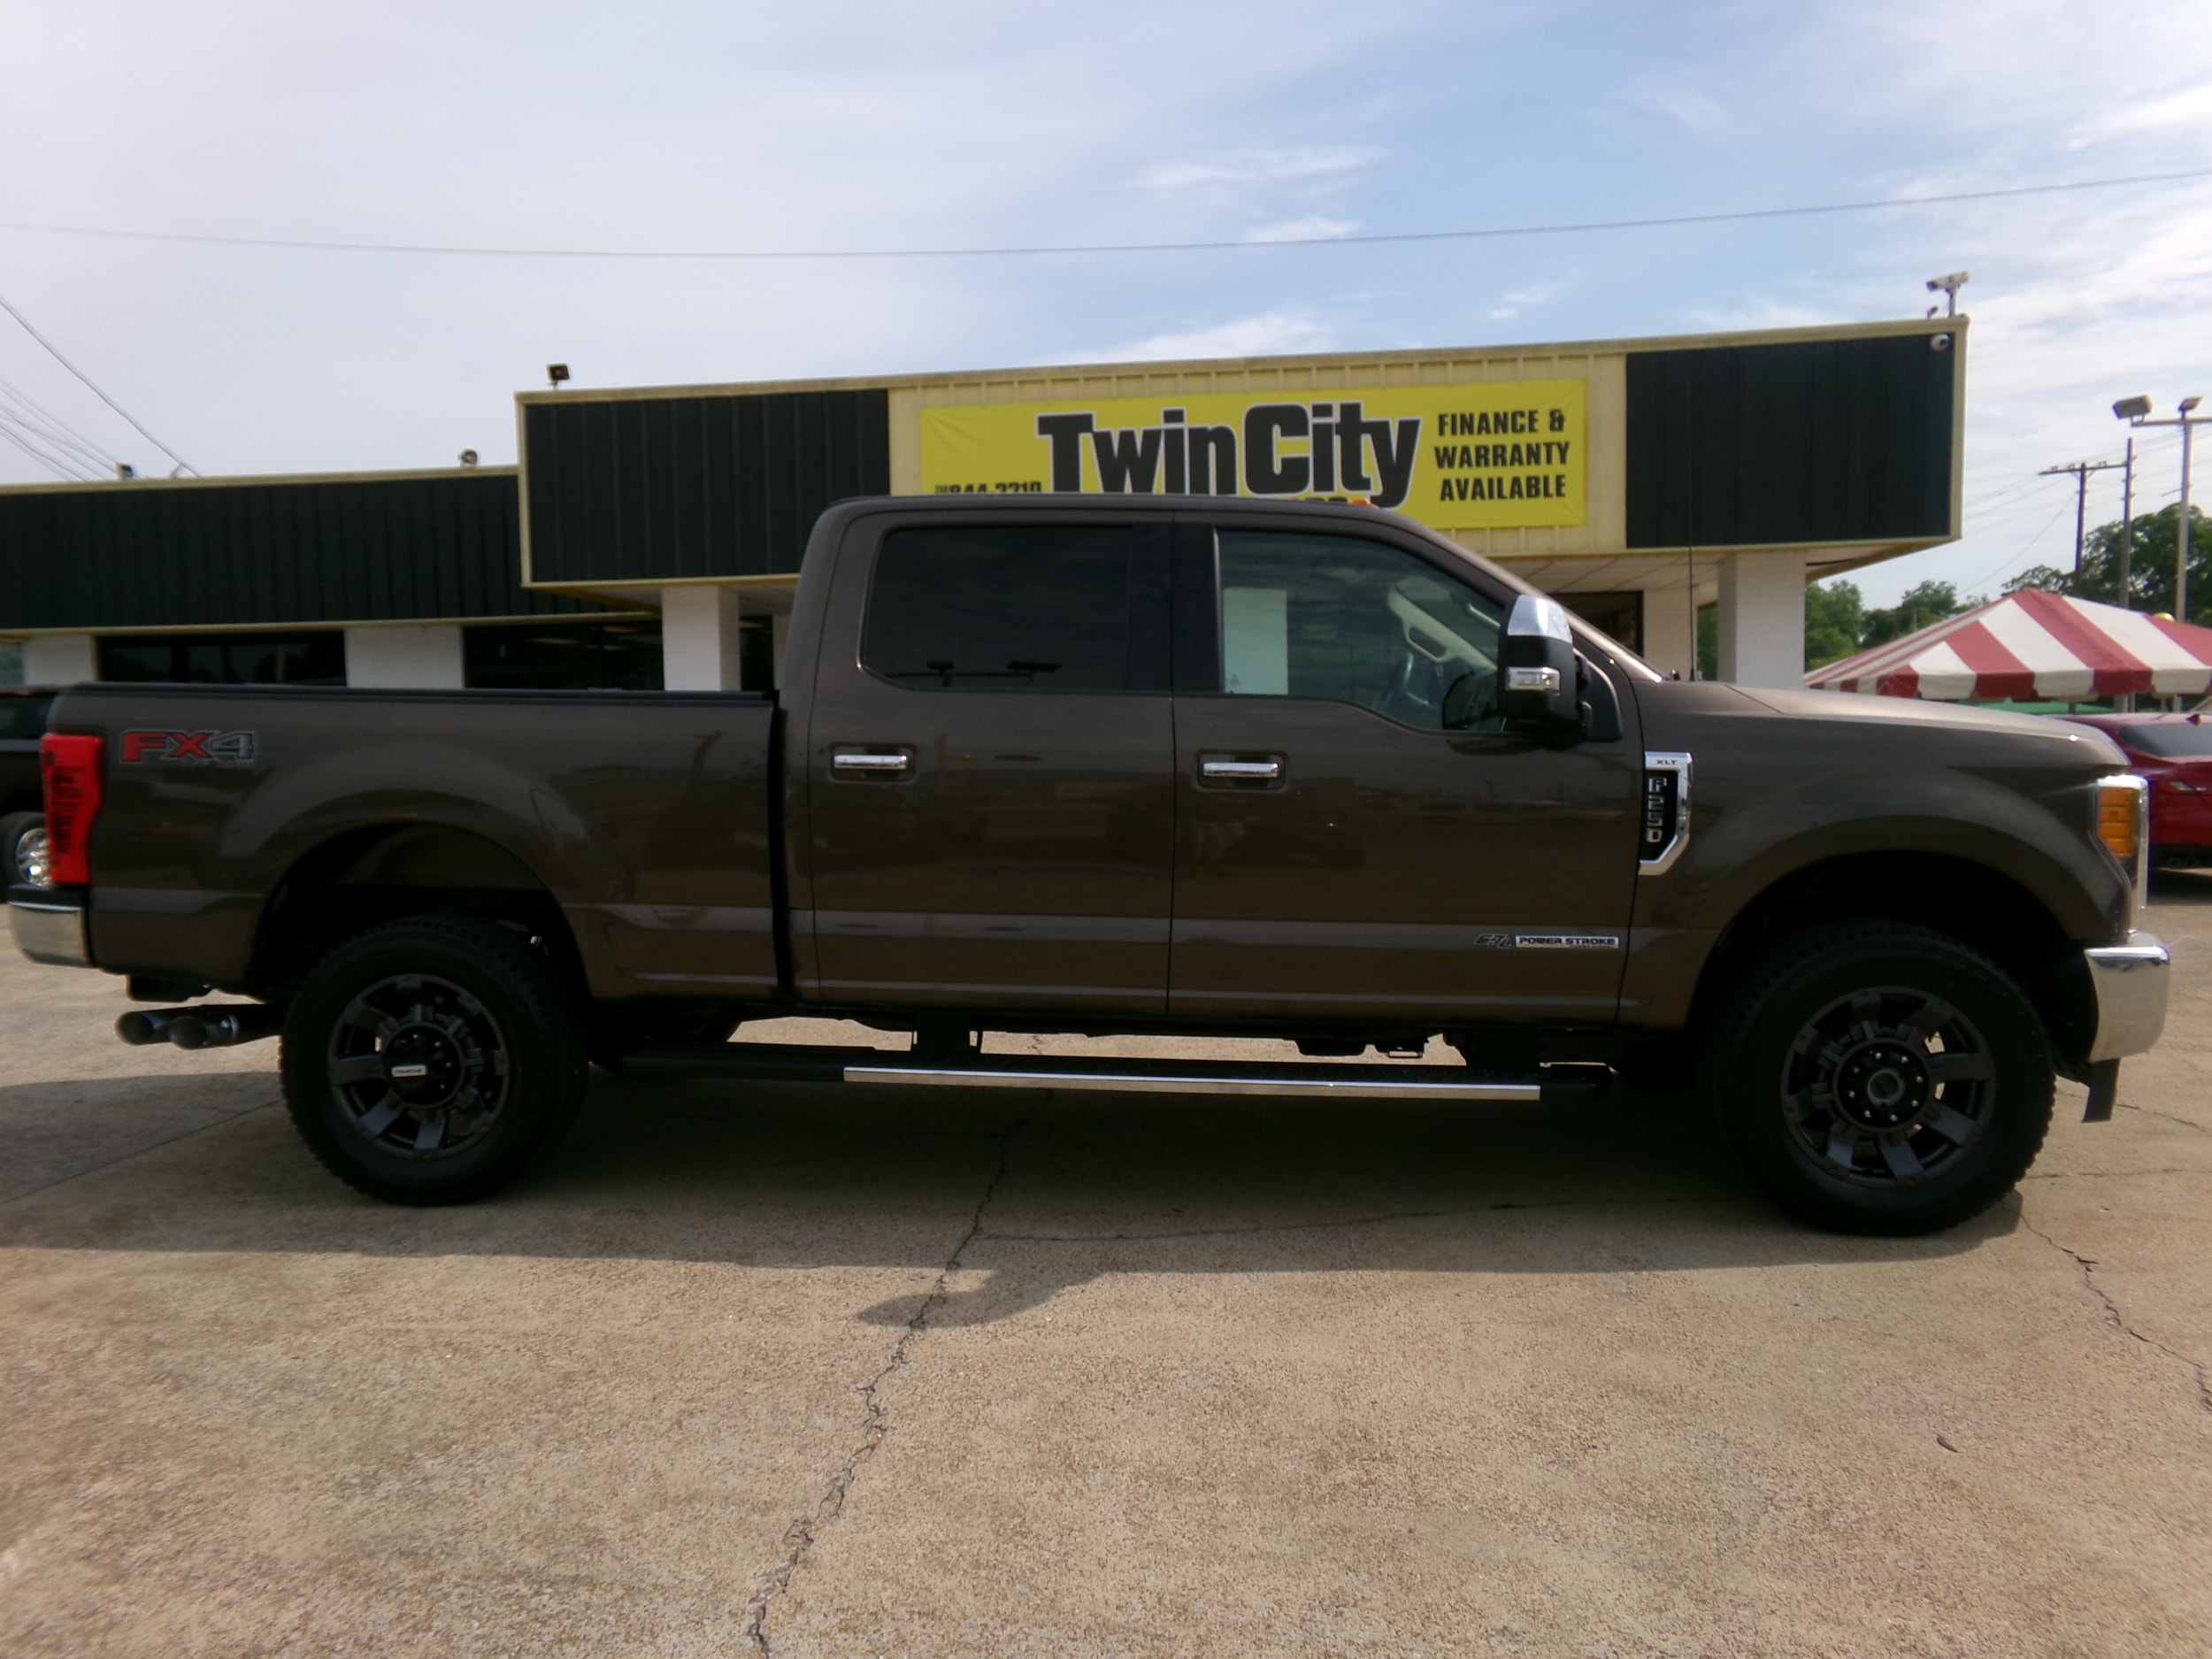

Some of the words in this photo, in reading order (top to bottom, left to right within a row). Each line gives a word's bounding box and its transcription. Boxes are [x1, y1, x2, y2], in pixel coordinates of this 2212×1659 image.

[1438, 410, 1539, 436] FINANCE
[1549, 408, 1565, 432] &
[1434, 442, 1570, 469] WARRANTY
[1440, 474, 1566, 502] AVAILABLE
[120, 728, 255, 764] FX4
